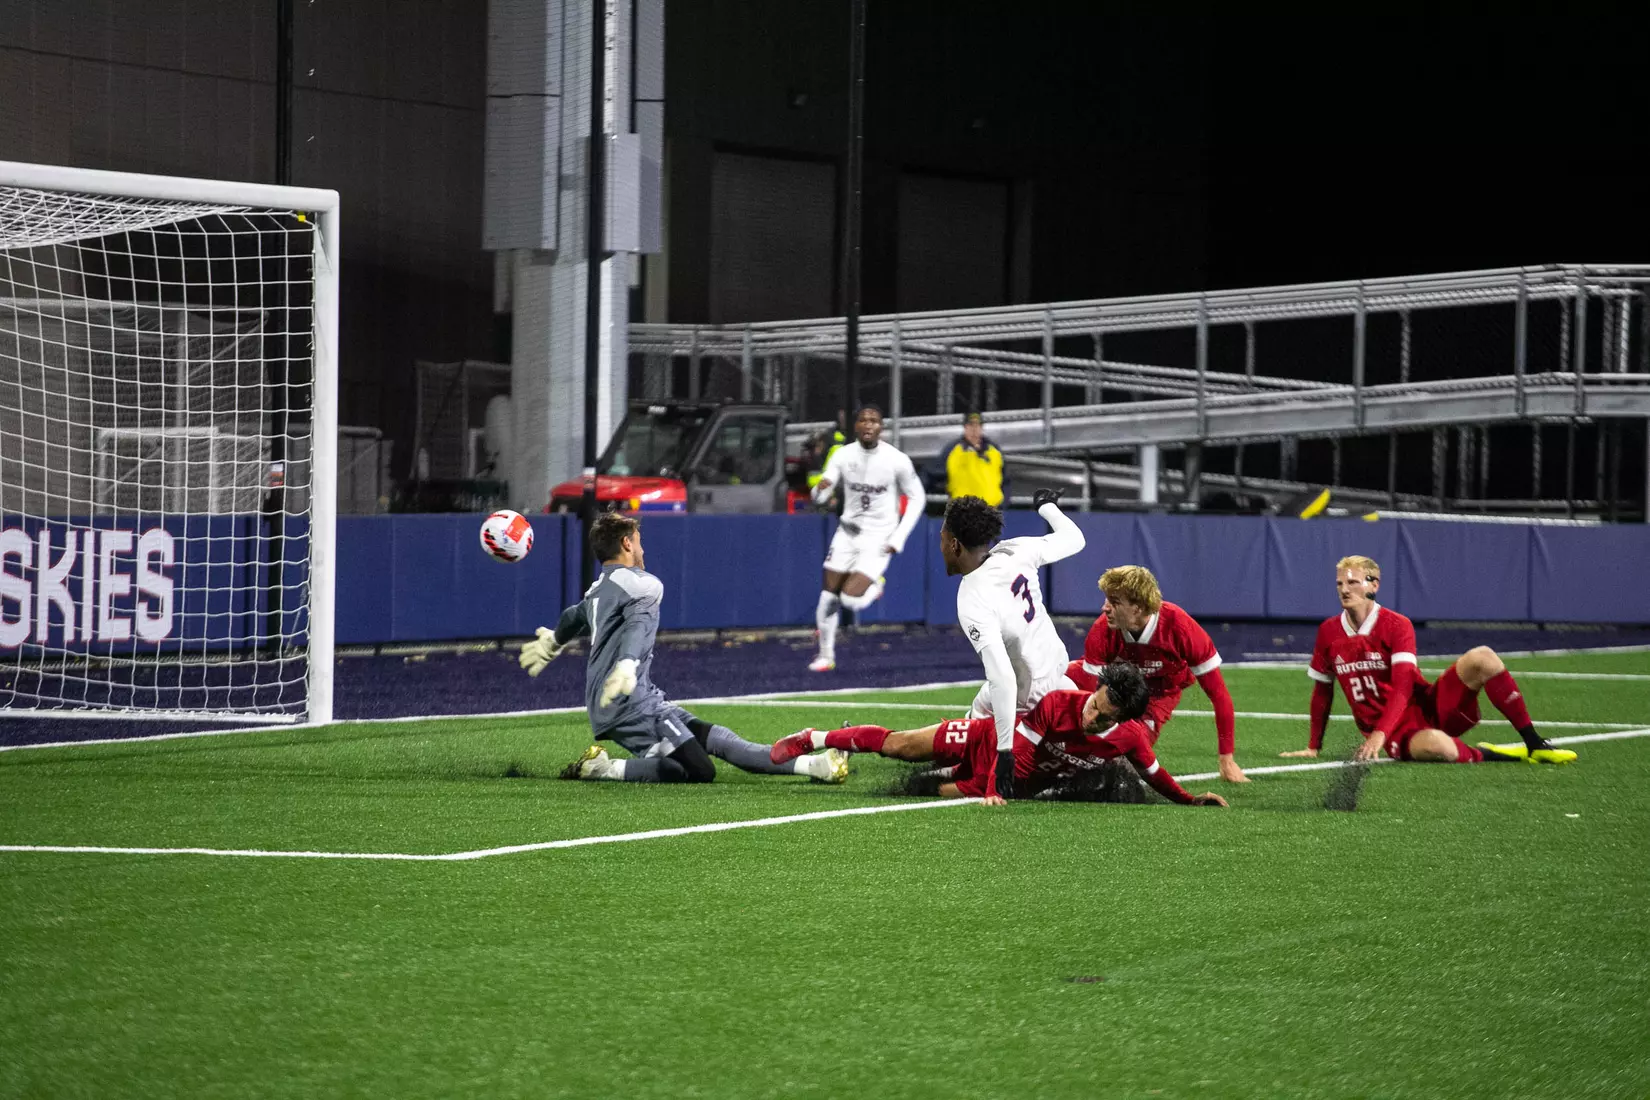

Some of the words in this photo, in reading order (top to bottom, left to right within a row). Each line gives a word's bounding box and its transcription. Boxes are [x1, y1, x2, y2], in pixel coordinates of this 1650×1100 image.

[1010, 573, 1036, 624] 3
[1335, 660, 1388, 675] RUTGERS
[1349, 675, 1380, 701] 24
[945, 721, 970, 744] 22
